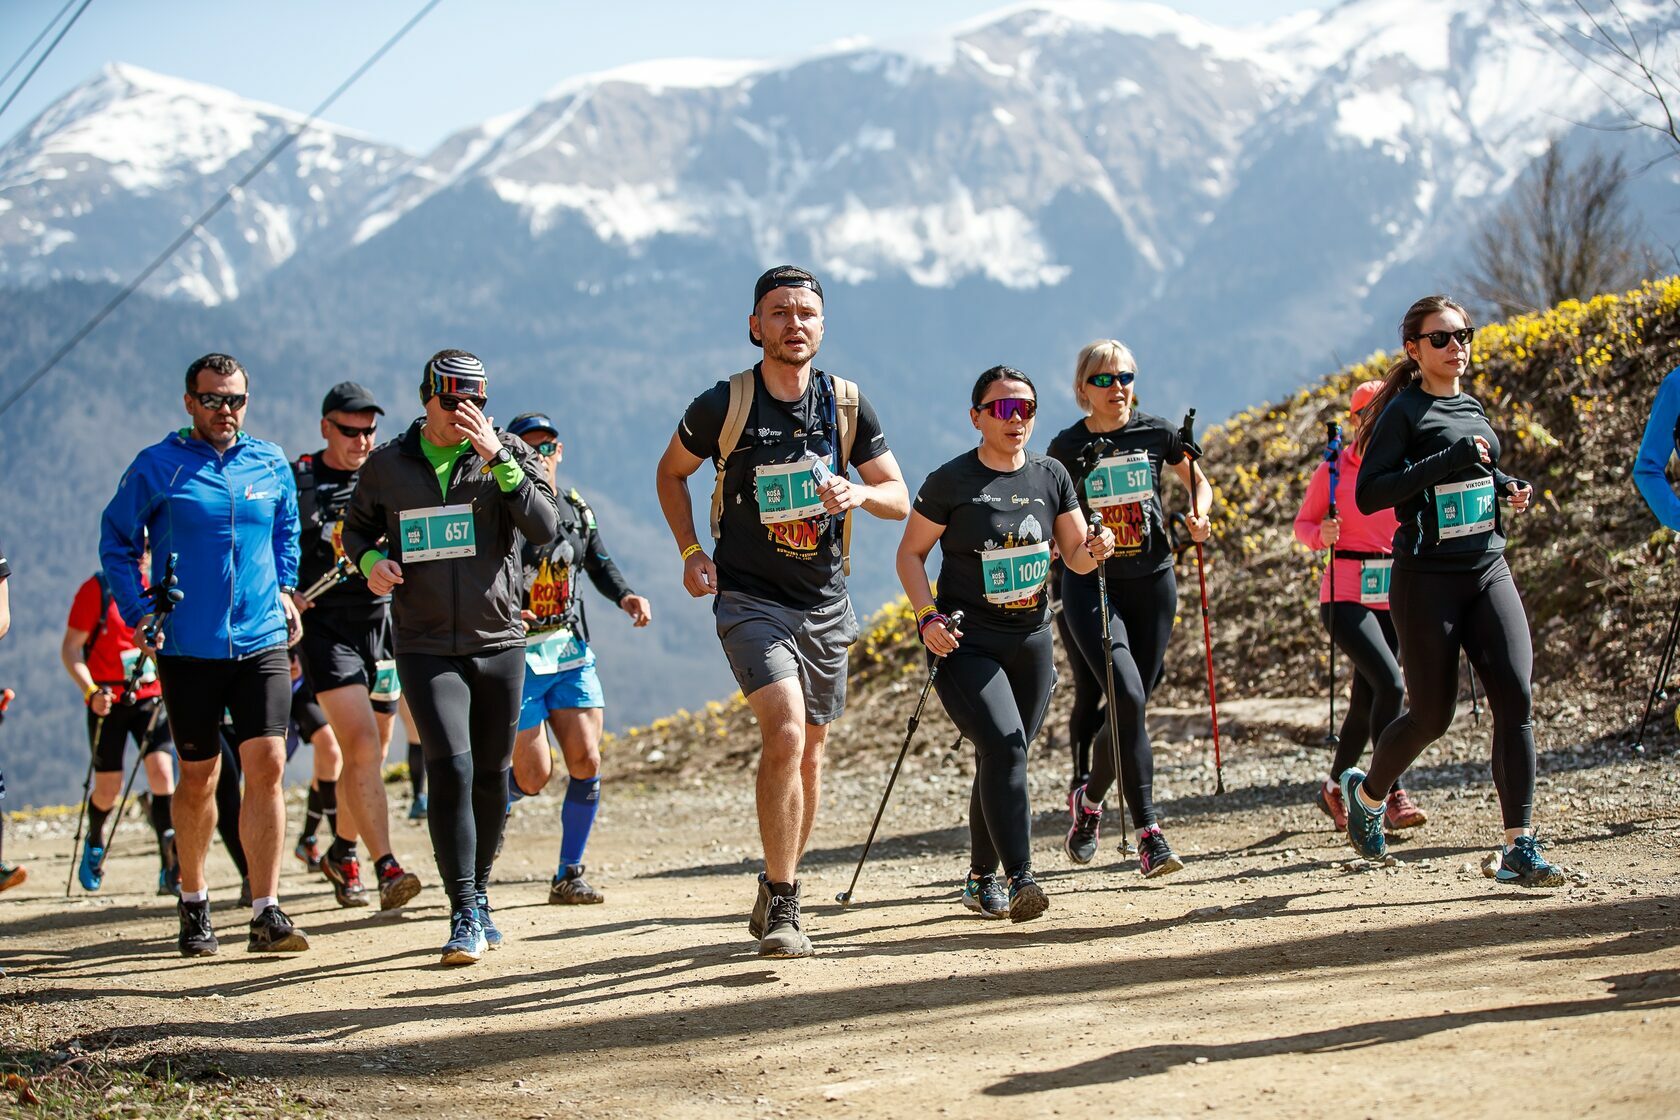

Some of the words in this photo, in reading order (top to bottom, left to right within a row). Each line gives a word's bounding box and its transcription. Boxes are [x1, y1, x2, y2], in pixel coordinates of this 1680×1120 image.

[801, 478, 816, 499] 11
[1126, 469, 1147, 487] 517
[1465, 479, 1491, 489] VIKTORIYA
[766, 489, 781, 497] ROSA
[1444, 506, 1456, 514] ROSA
[1476, 494, 1493, 515] 715
[445, 521, 469, 542] 657
[774, 520, 817, 548] RUN
[991, 572, 1005, 580] ROSA
[1019, 559, 1048, 583] 1002
[533, 580, 570, 602] ROSA
